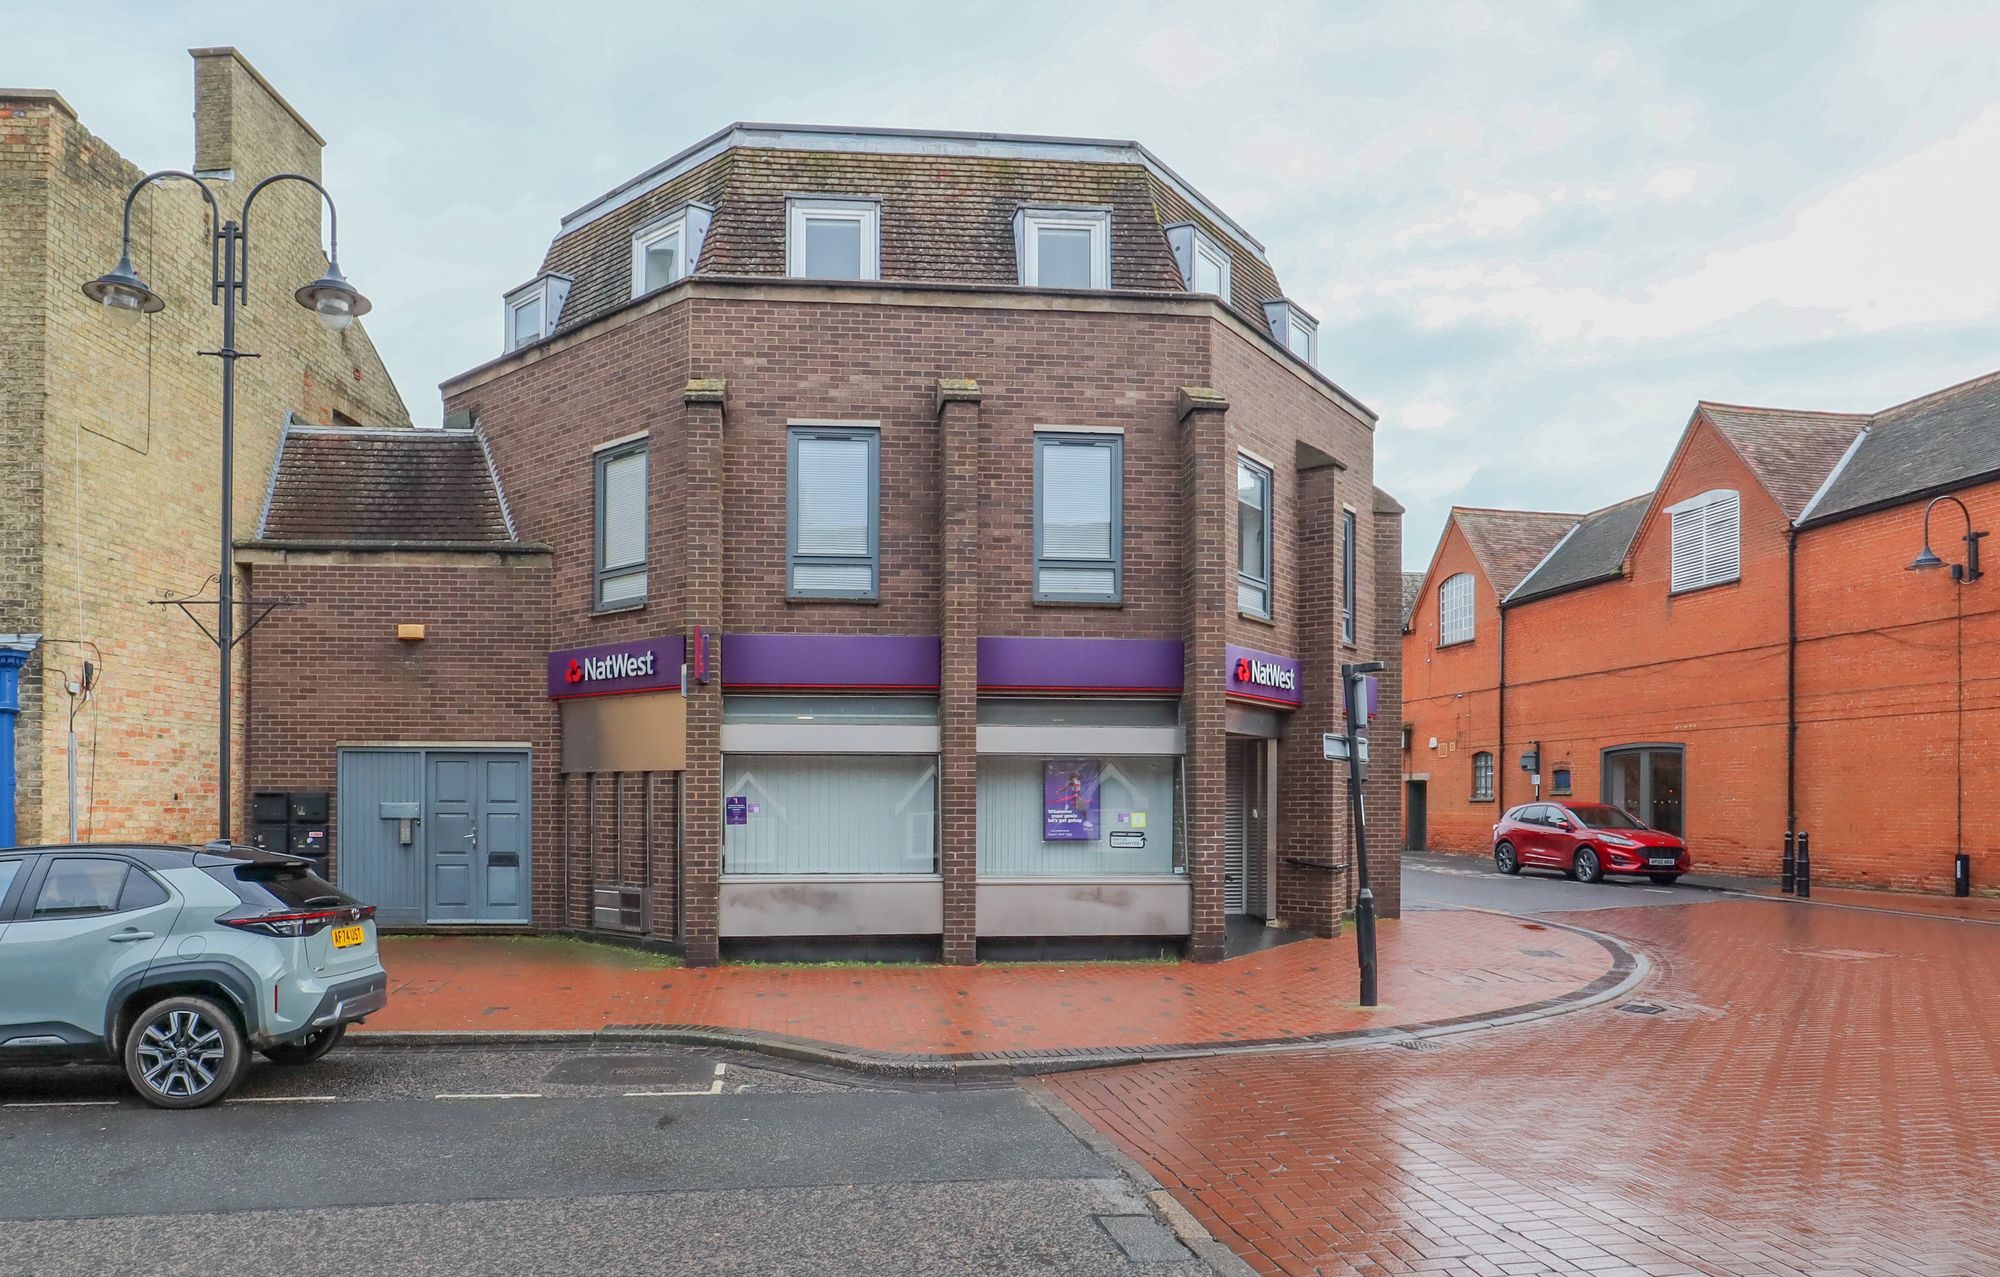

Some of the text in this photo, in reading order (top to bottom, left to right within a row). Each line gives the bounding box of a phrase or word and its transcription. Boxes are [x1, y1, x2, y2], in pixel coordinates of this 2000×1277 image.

[584, 650, 654, 681] NatWest
[1251, 659, 1295, 690] NatWest
[334, 927, 361, 945] AF74 UST
